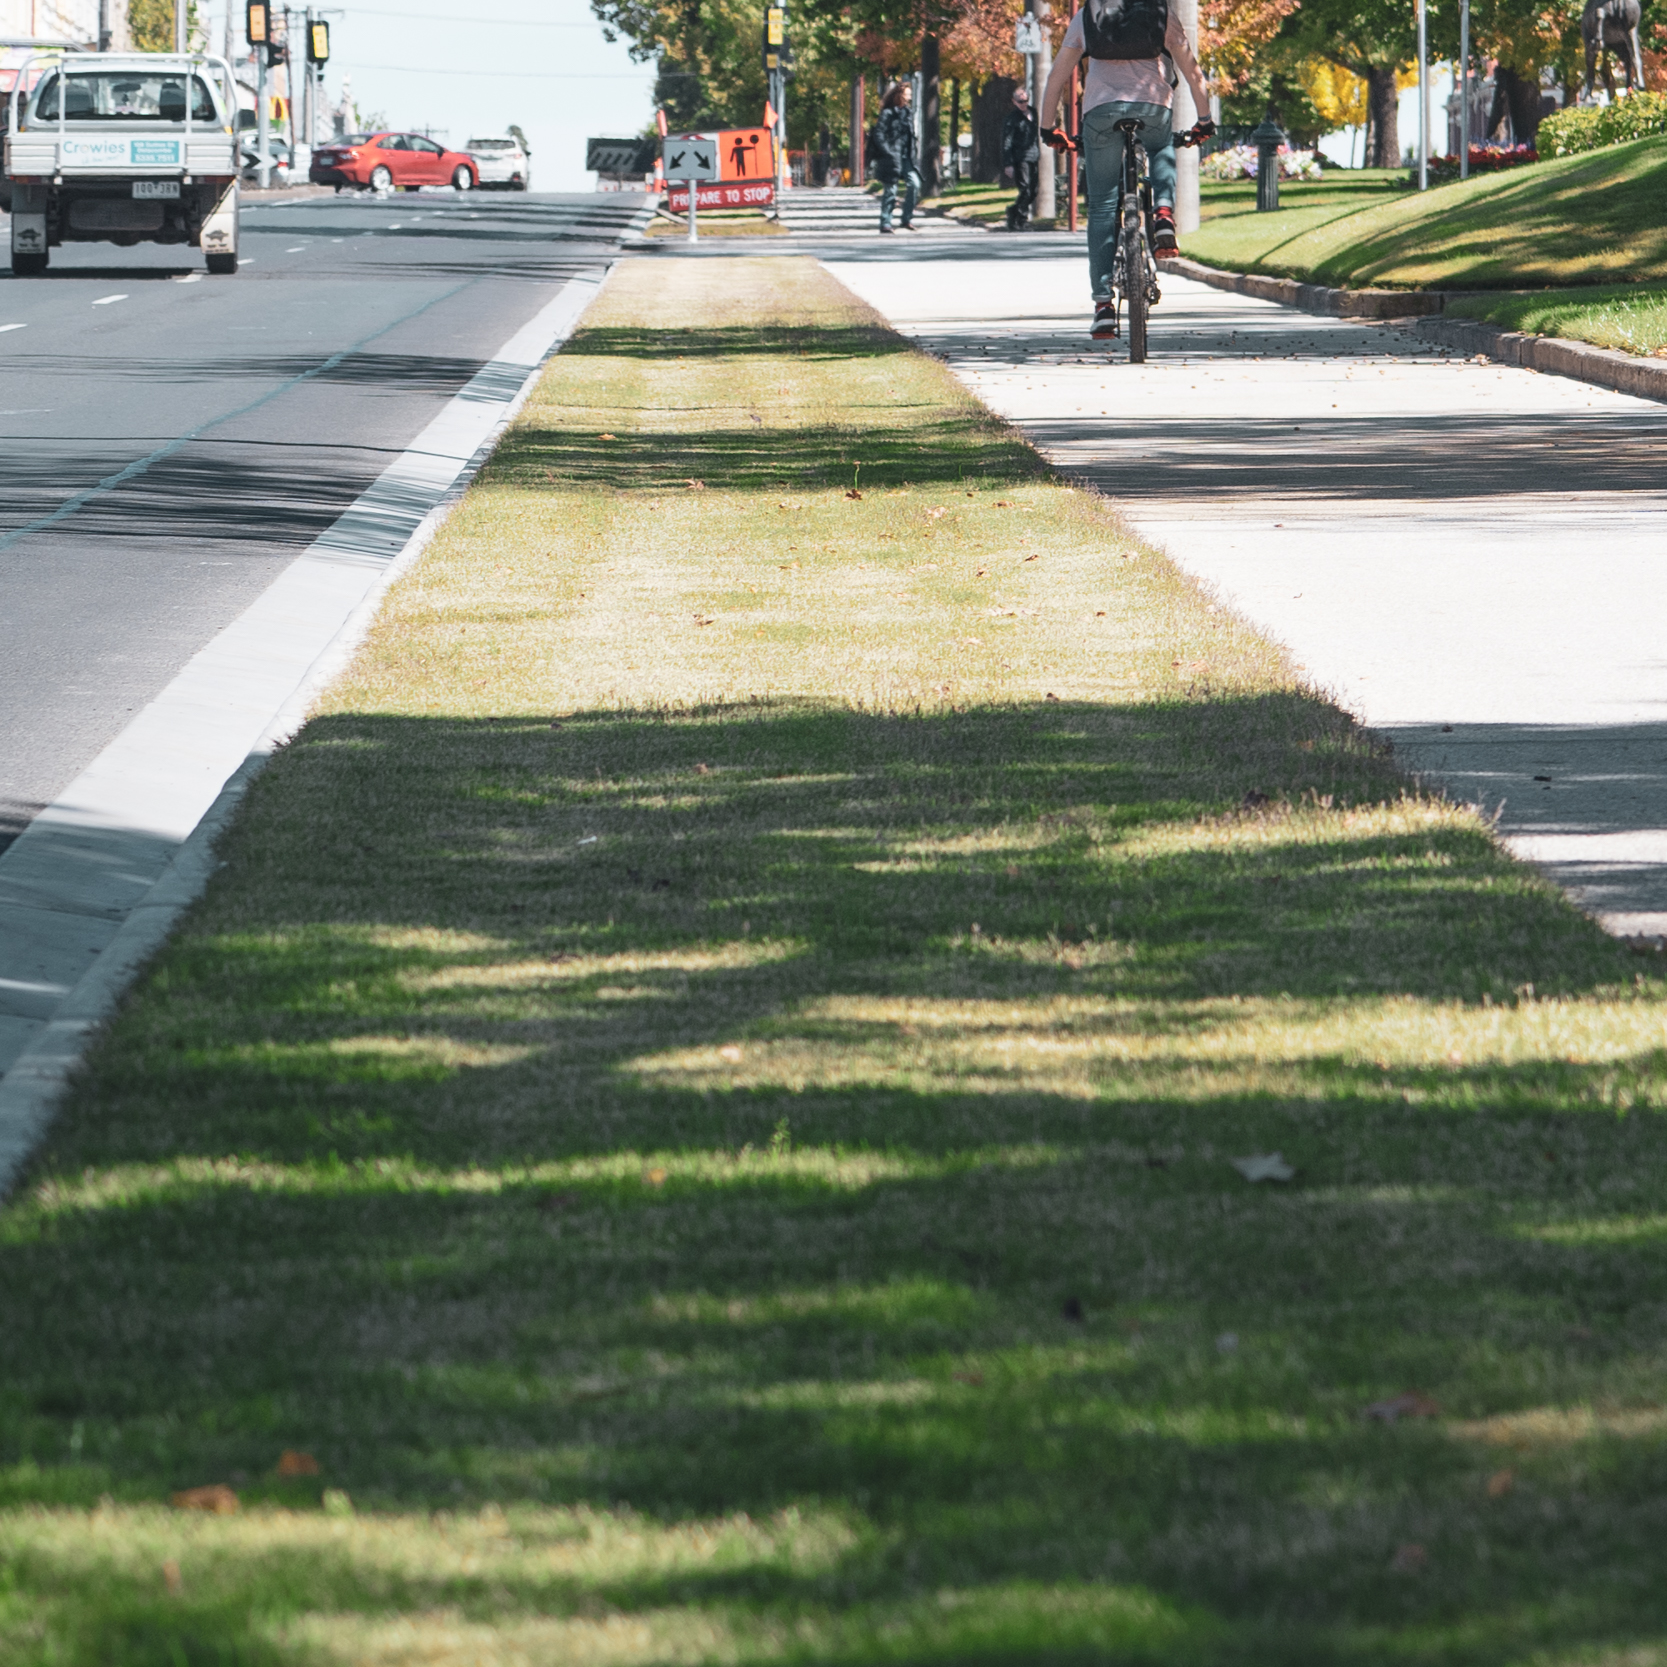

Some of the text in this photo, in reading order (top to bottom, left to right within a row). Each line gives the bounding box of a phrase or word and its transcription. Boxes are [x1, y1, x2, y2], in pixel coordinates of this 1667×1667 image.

[63, 140, 126, 154] Crowies
[725, 190, 740, 203] TO
[744, 188, 770, 202] STOP
